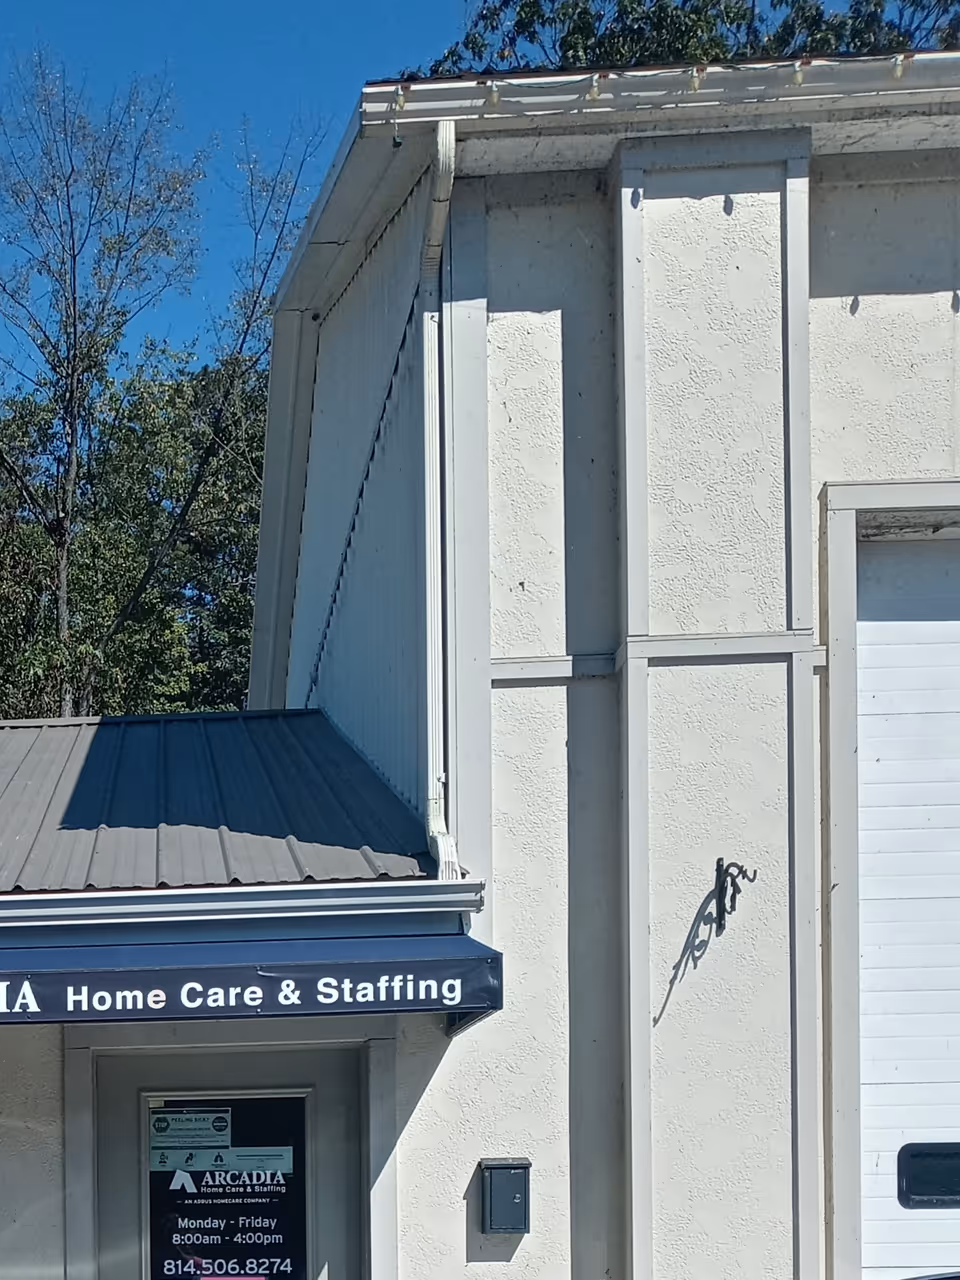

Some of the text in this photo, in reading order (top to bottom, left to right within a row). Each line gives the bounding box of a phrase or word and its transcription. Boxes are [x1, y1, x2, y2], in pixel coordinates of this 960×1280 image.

[66, 974, 463, 1012] Home Care & Staffing
[155, 1121, 168, 1129] STOP
[201, 1170, 286, 1186] ARCADIA
[200, 1185, 286, 1195] Home Care & Staffing
[177, 1217, 227, 1230] Monday
[238, 1216, 278, 1230] Friday
[171, 1233, 221, 1244] 8:00am
[233, 1232, 283, 1246] 4:00pm
[163, 1258, 293, 1275] 814.506.8274
